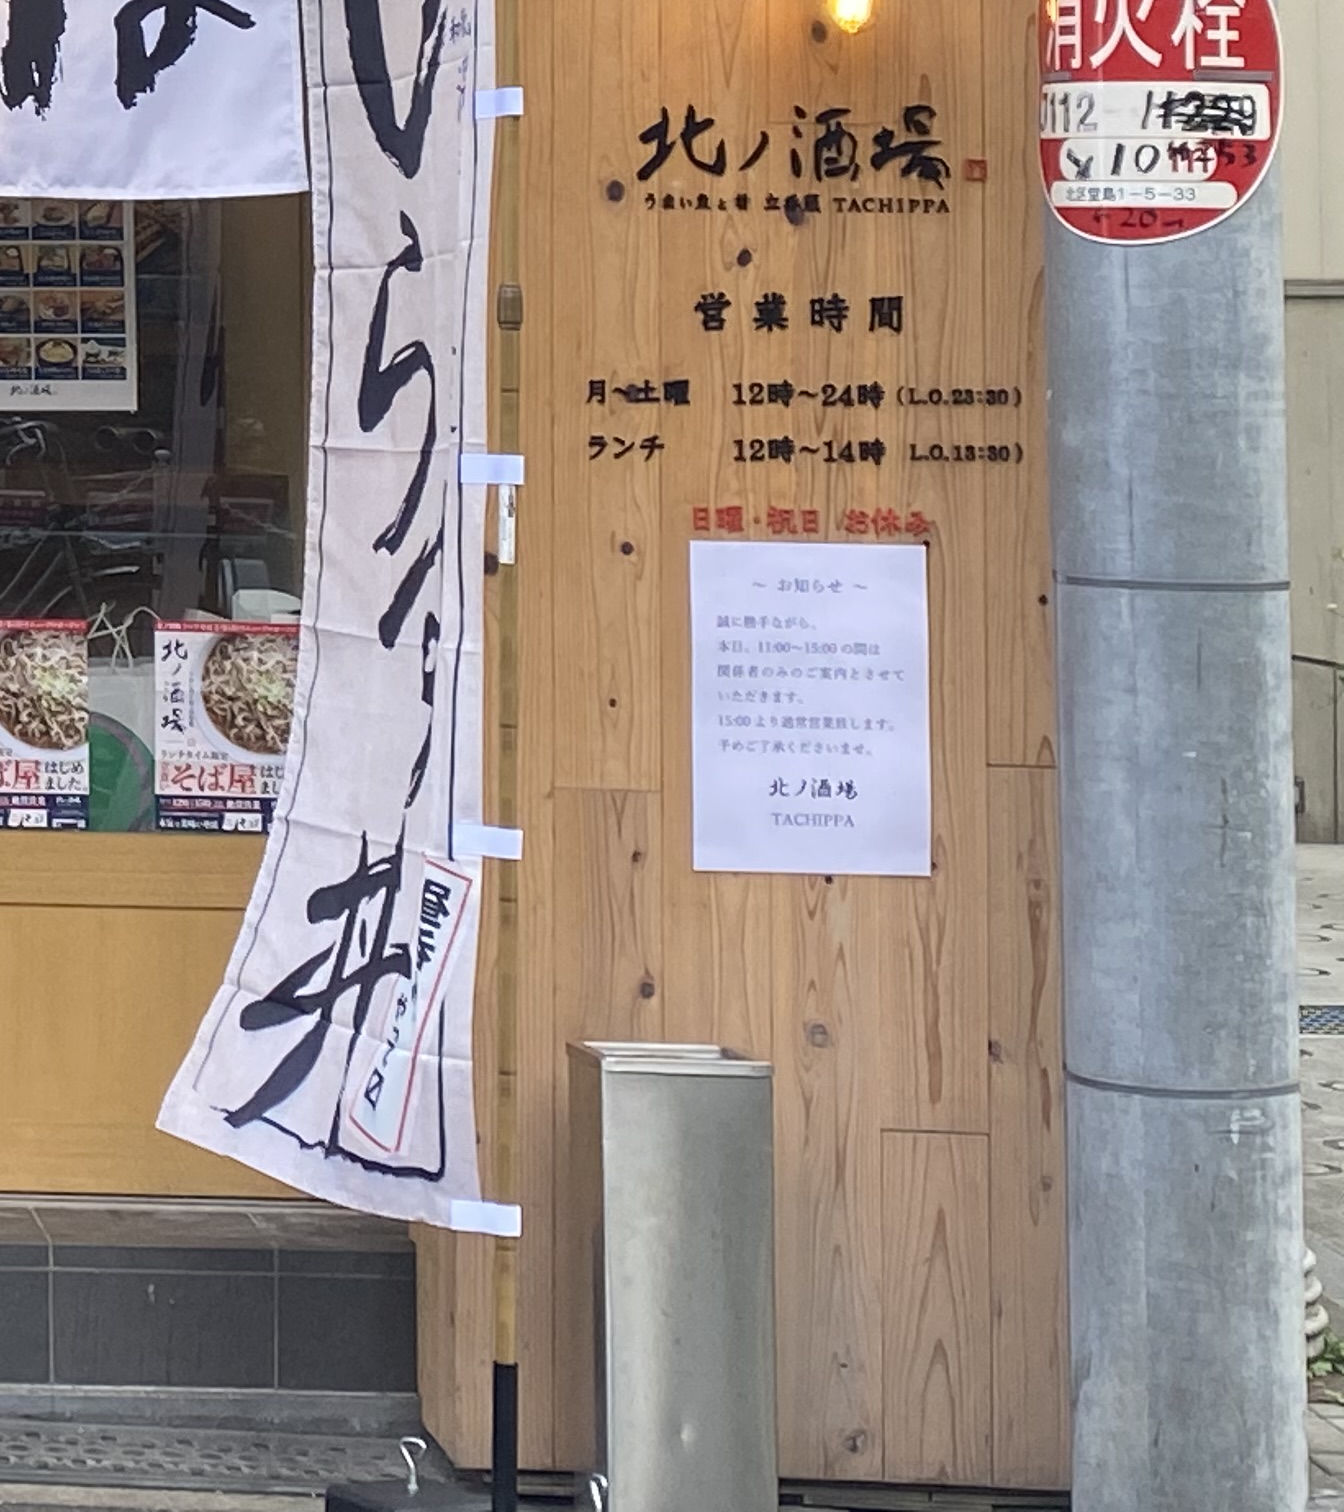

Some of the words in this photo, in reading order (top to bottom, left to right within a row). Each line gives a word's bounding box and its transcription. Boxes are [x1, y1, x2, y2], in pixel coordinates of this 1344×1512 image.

[636, 104, 951, 190] 北ノ酒場
[832, 196, 951, 215] TACHIPPA
[694, 292, 904, 334] 営業時間
[587, 434, 665, 464] ランチ
[843, 508, 932, 535] お休み
[777, 578, 844, 594] お知らせ
[44, 760, 84, 774] はじめ
[171, 763, 256, 795] そば屋
[769, 777, 859, 800] 北ノ酒場
[772, 813, 854, 828] TACHIPPA
